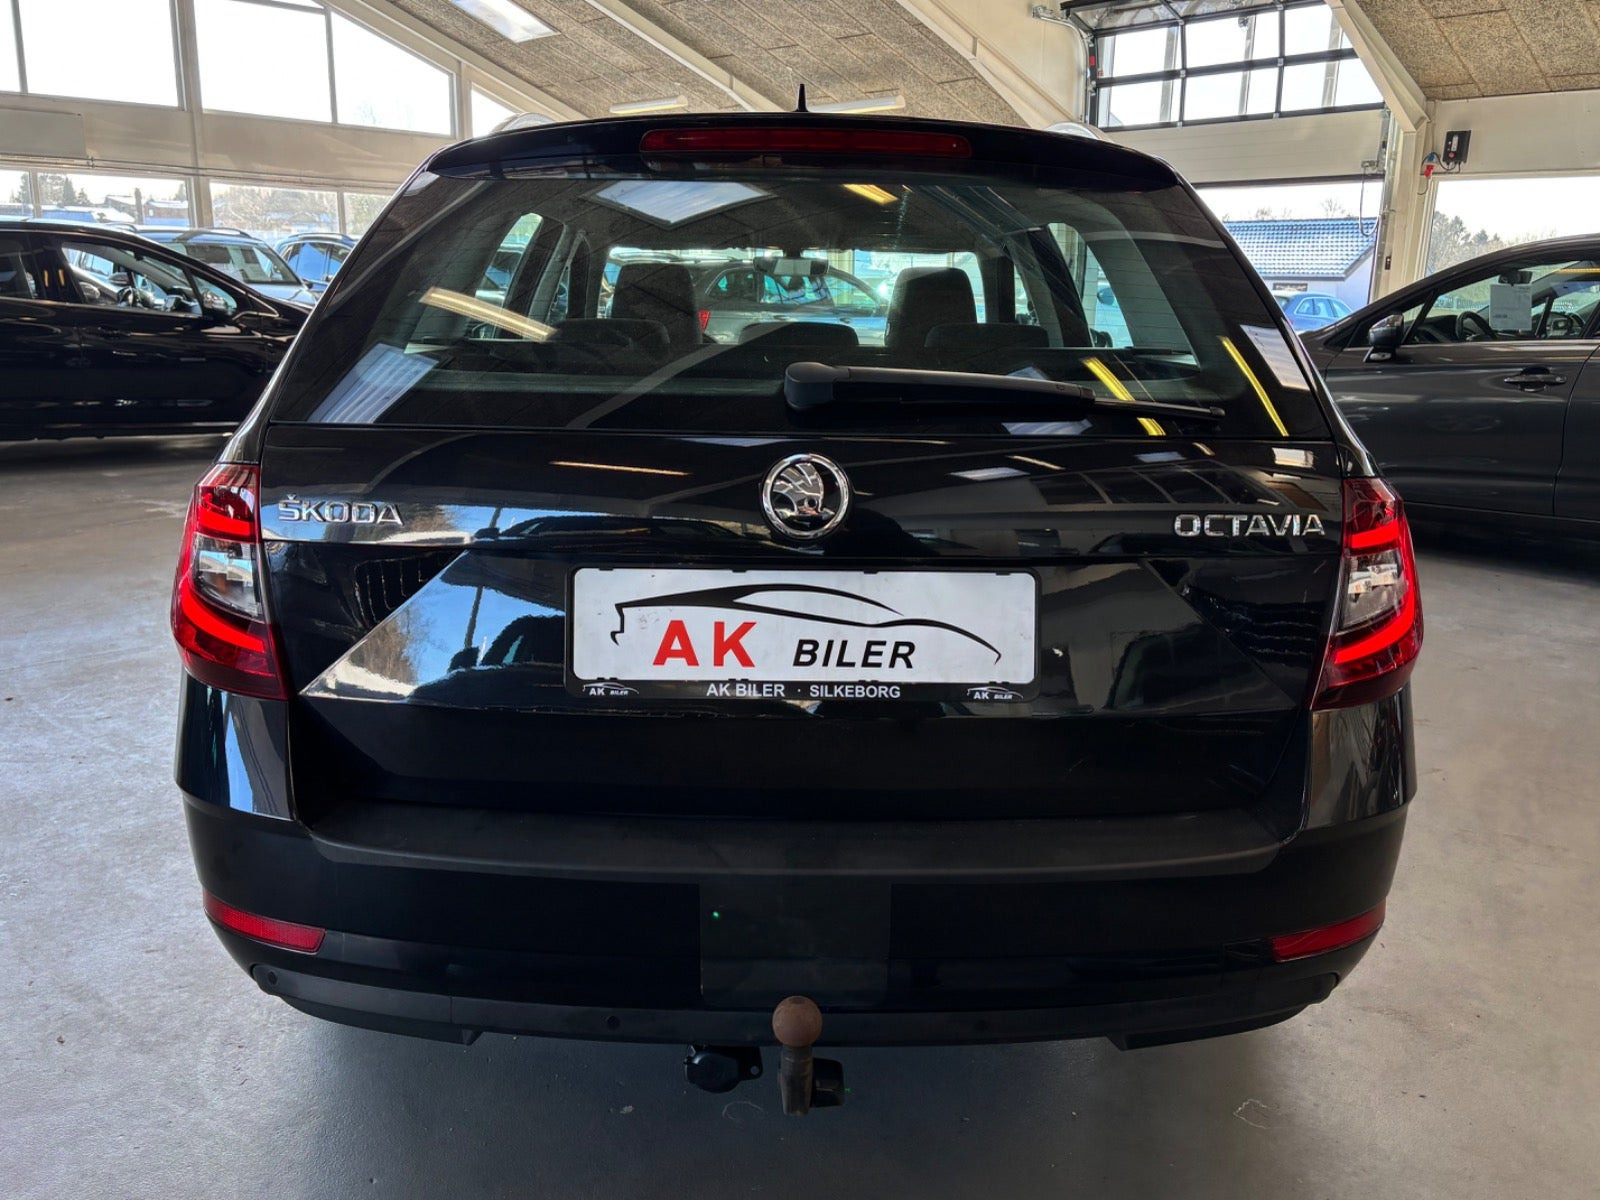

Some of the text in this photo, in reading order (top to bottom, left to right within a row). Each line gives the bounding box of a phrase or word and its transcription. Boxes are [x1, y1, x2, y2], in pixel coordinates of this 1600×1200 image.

[278, 494, 404, 526] ŠKODA
[1174, 514, 1326, 537] OCTAVIA
[792, 638, 916, 670] BILER
[588, 687, 605, 696] AK
[706, 683, 901, 699] AK BILER SILKEBORG
[973, 691, 990, 700] AK
